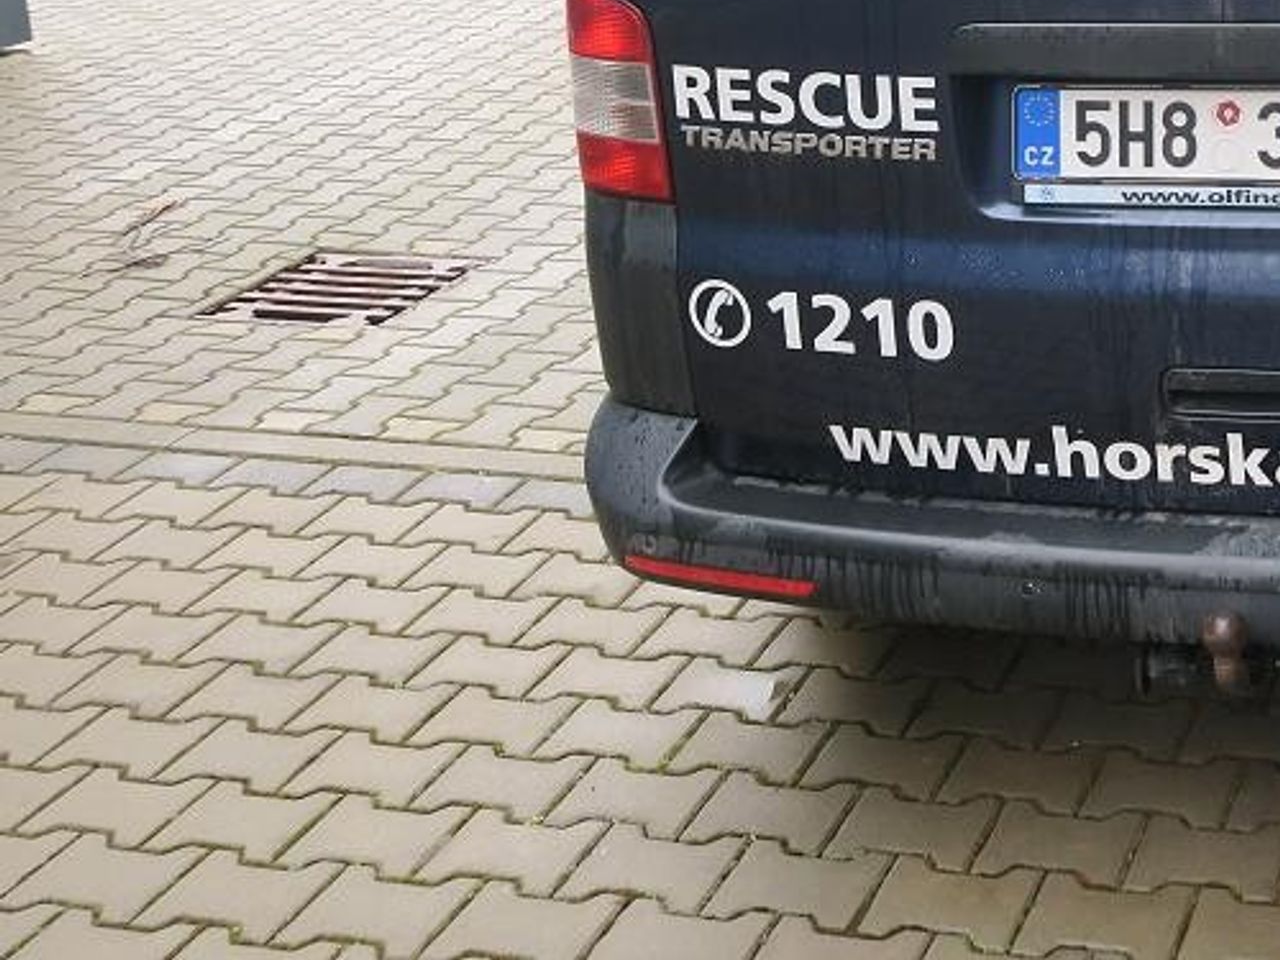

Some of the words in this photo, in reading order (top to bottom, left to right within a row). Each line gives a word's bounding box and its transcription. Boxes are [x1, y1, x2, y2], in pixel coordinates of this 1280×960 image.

[671, 64, 940, 132] RESCUE
[681, 125, 937, 161] TRANSPORTER
[1024, 145, 1056, 166] CZ
[1074, 100, 1198, 168] 5H8
[767, 291, 955, 360] 1210
